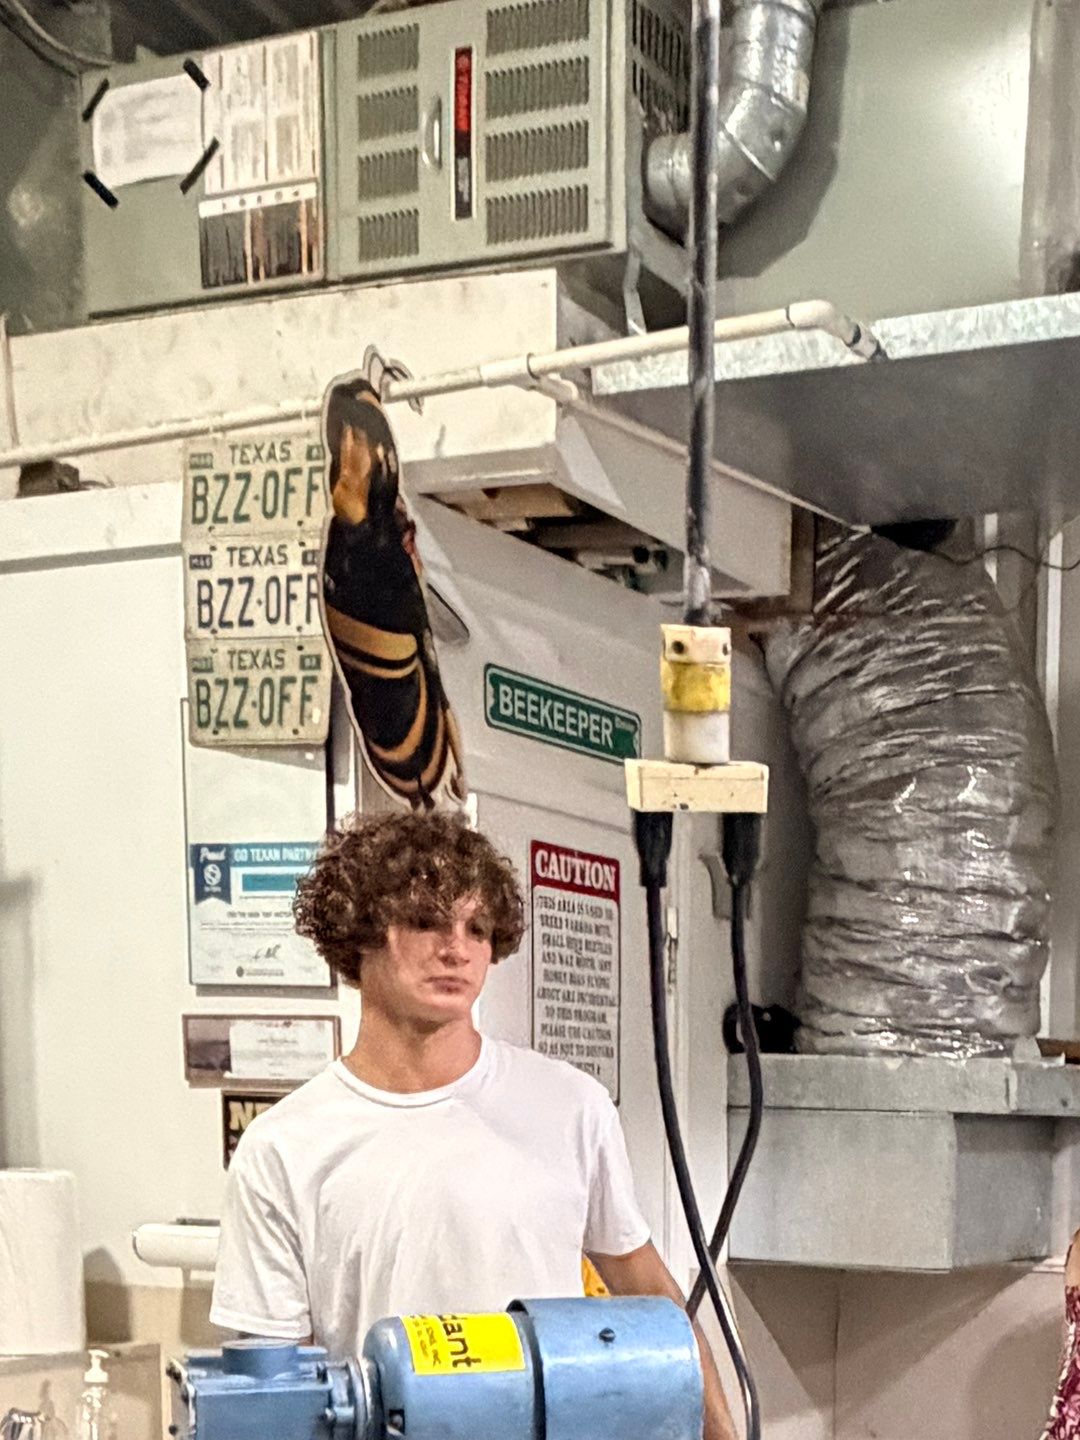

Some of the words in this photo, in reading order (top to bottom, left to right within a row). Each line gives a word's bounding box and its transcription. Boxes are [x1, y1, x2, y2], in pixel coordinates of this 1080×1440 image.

[229, 441, 292, 464] TEXAS
[227, 544, 288, 567] TEXAS
[228, 649, 286, 670] TEXAS
[499, 682, 614, 750] BEEKEEPER
[535, 849, 617, 893] CAUTION
